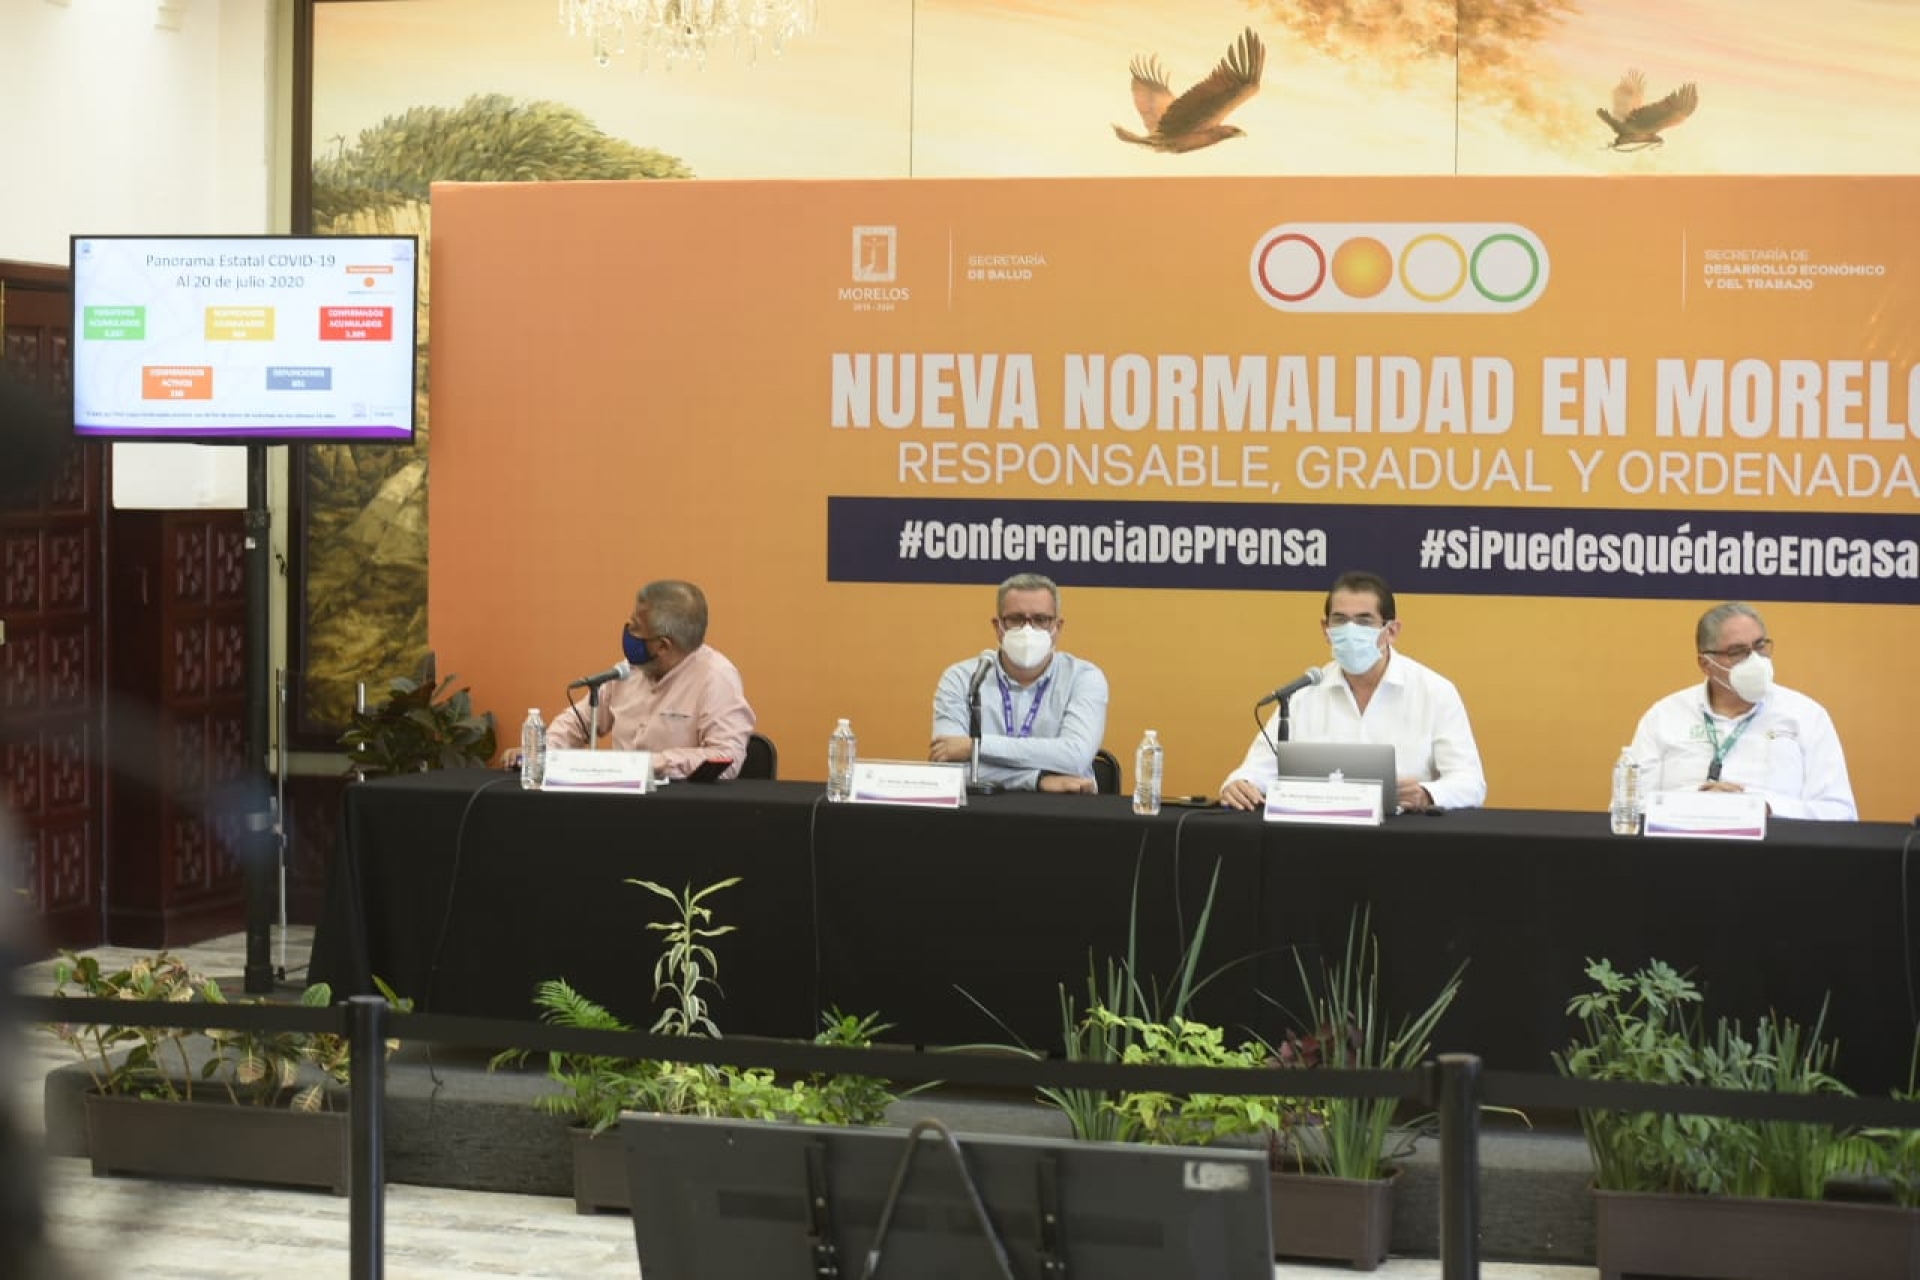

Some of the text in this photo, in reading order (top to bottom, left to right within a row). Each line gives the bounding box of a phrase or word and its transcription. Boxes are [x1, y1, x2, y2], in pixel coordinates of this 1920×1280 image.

[146, 254, 335, 267] Panorama Estatal COVID-19
[1704, 248, 1808, 261] SECRETARÍA DE
[968, 269, 1033, 280] DE SALUD
[1704, 261, 1886, 276] DESARROLLO ECONÓMICO
[176, 275, 305, 290] Al 20 de julio 2020
[1704, 278, 1813, 289] Y DEL TRABAJO
[838, 287, 910, 301] MORELOS
[830, 353, 1920, 440] NUEVA NORMALIDAD EN MOREL
[899, 441, 1920, 498] RESPONSABLE, GRADUAL Y ORDENADA
[899, 517, 1327, 566] #ConferenciaDePrensa
[1420, 522, 1919, 579] #SiPuedesQuédateEnCasa
